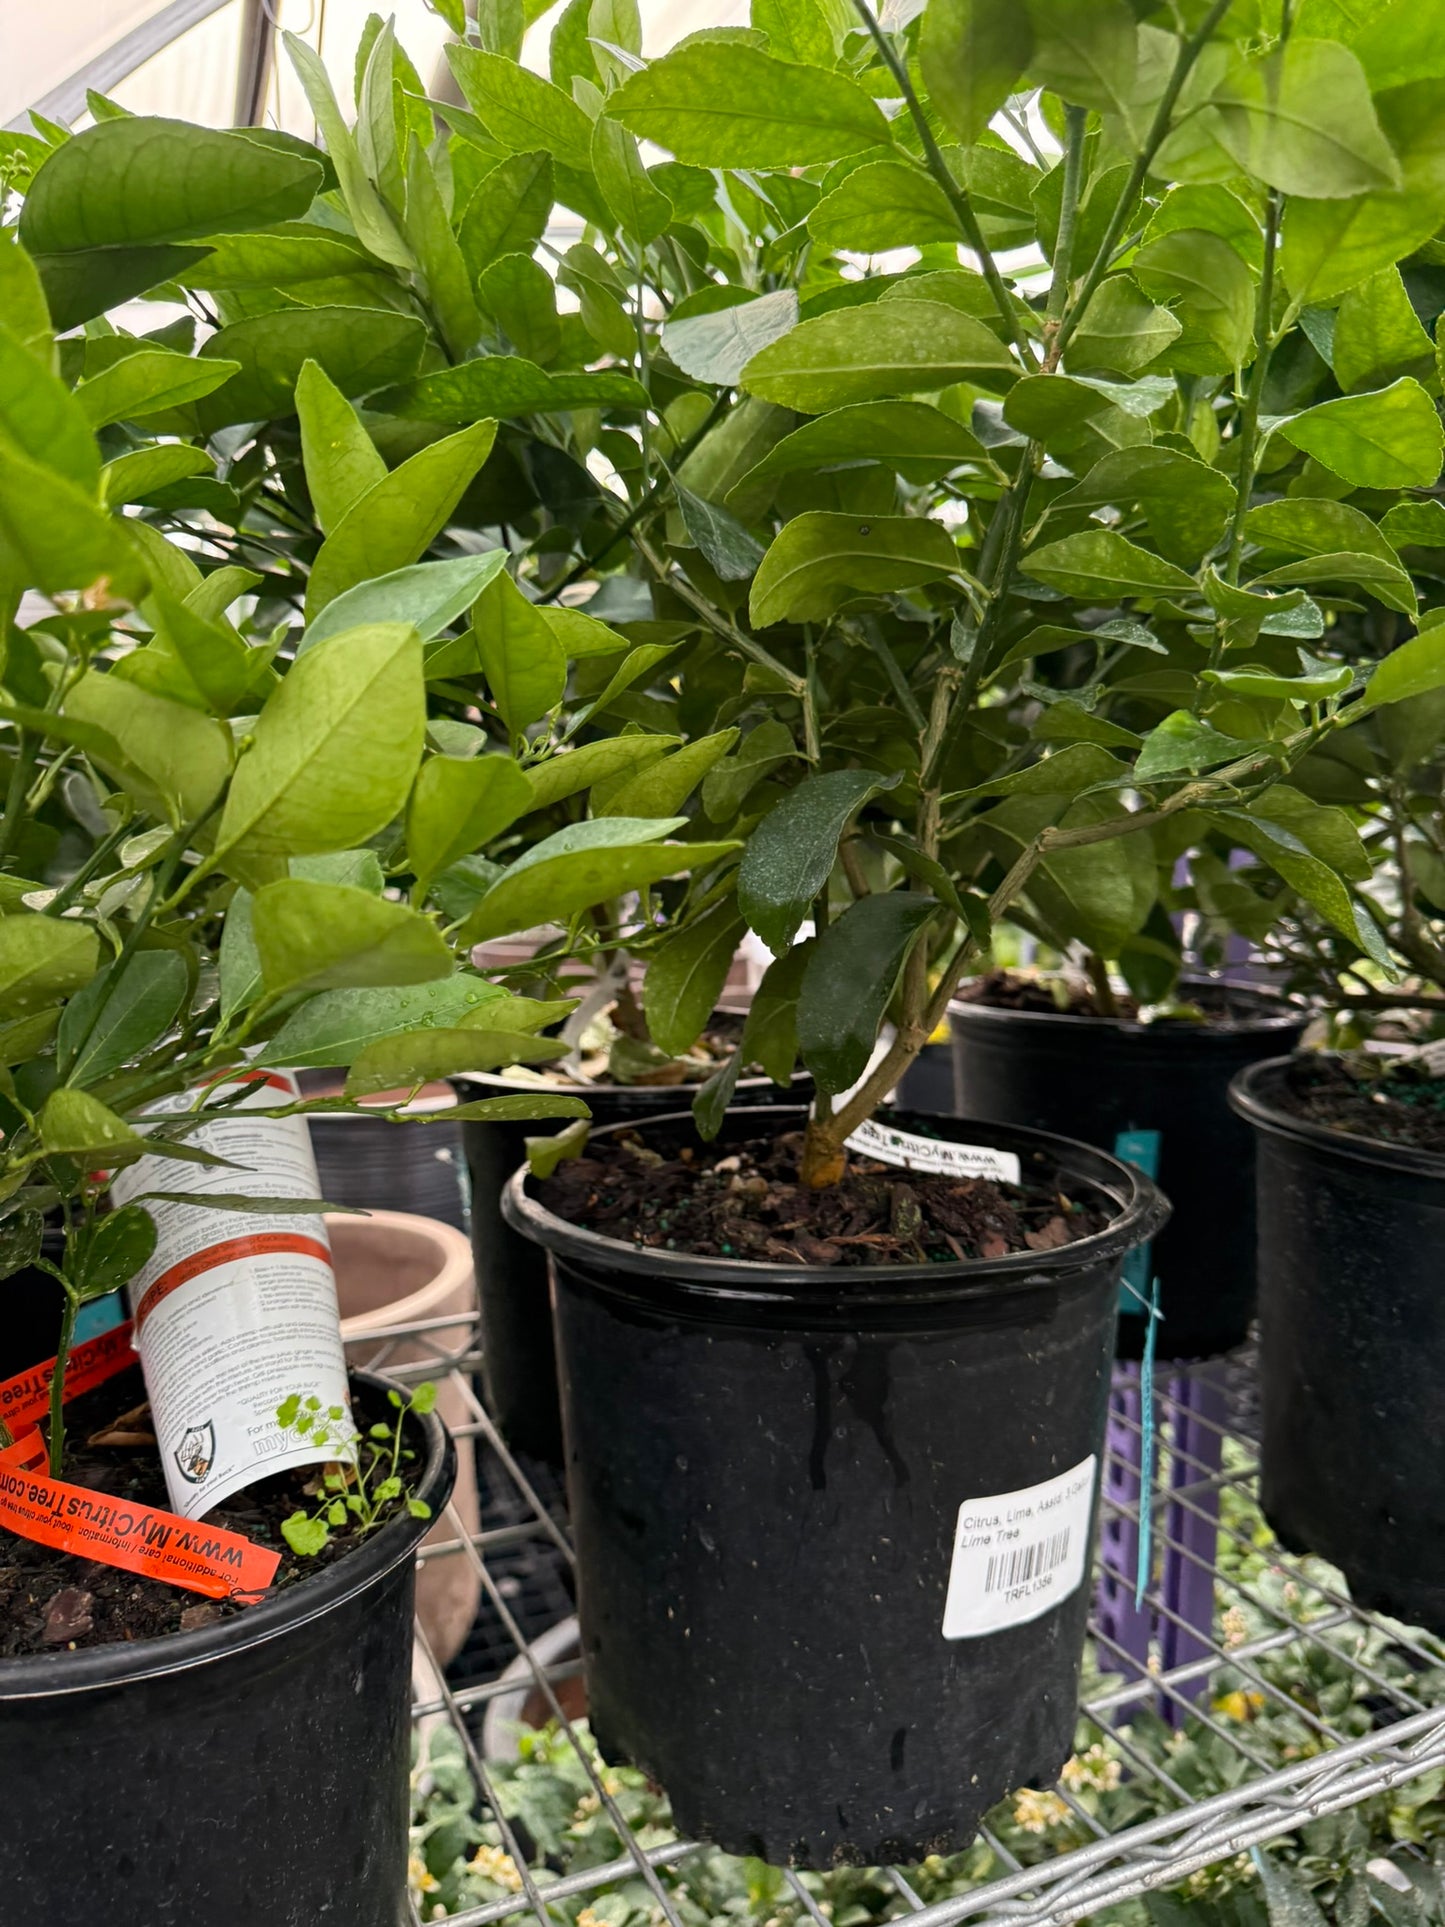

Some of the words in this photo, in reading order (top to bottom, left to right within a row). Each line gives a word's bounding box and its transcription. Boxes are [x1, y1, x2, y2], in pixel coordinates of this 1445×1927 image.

[247, 1424, 264, 1436] For
[19, 1507, 36, 1519] citrus
[36, 1512, 53, 1526] your
[963, 1514, 1002, 1530] Citrus,
[1006, 1506, 1035, 1523] Lime,
[78, 1526, 131, 1551] information
[961, 1533, 991, 1548] Lime
[996, 1528, 1021, 1544] Tree
[138, 1545, 161, 1559] care
[164, 1553, 217, 1576] additional
[219, 1571, 239, 1584] For
